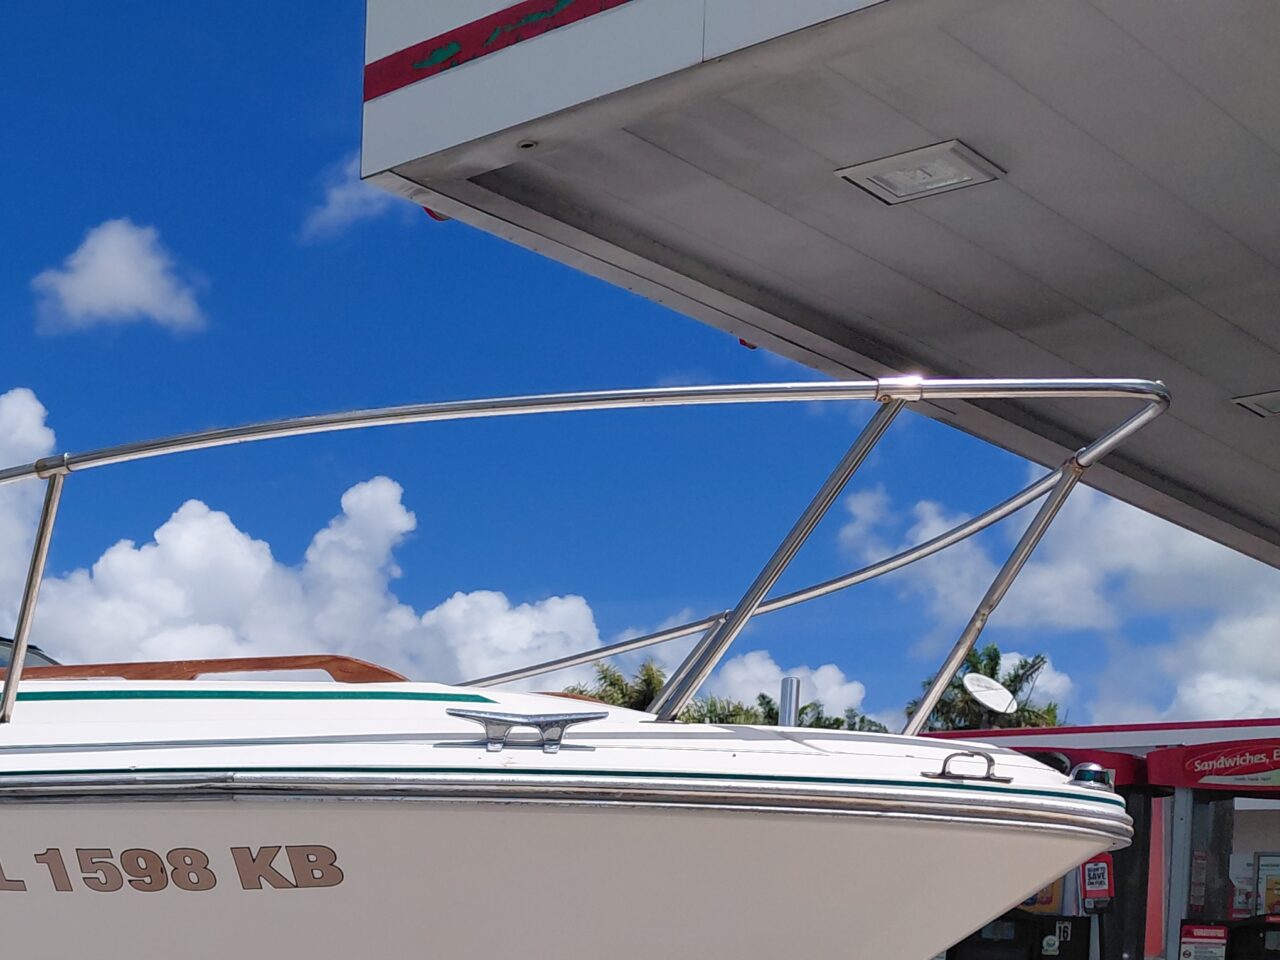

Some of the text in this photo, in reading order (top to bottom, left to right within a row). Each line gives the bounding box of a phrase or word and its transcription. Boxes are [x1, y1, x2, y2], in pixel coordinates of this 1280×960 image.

[1194, 752, 1269, 772] Sandwiches,
[34, 847, 217, 893] 1598
[230, 845, 344, 891] KB
